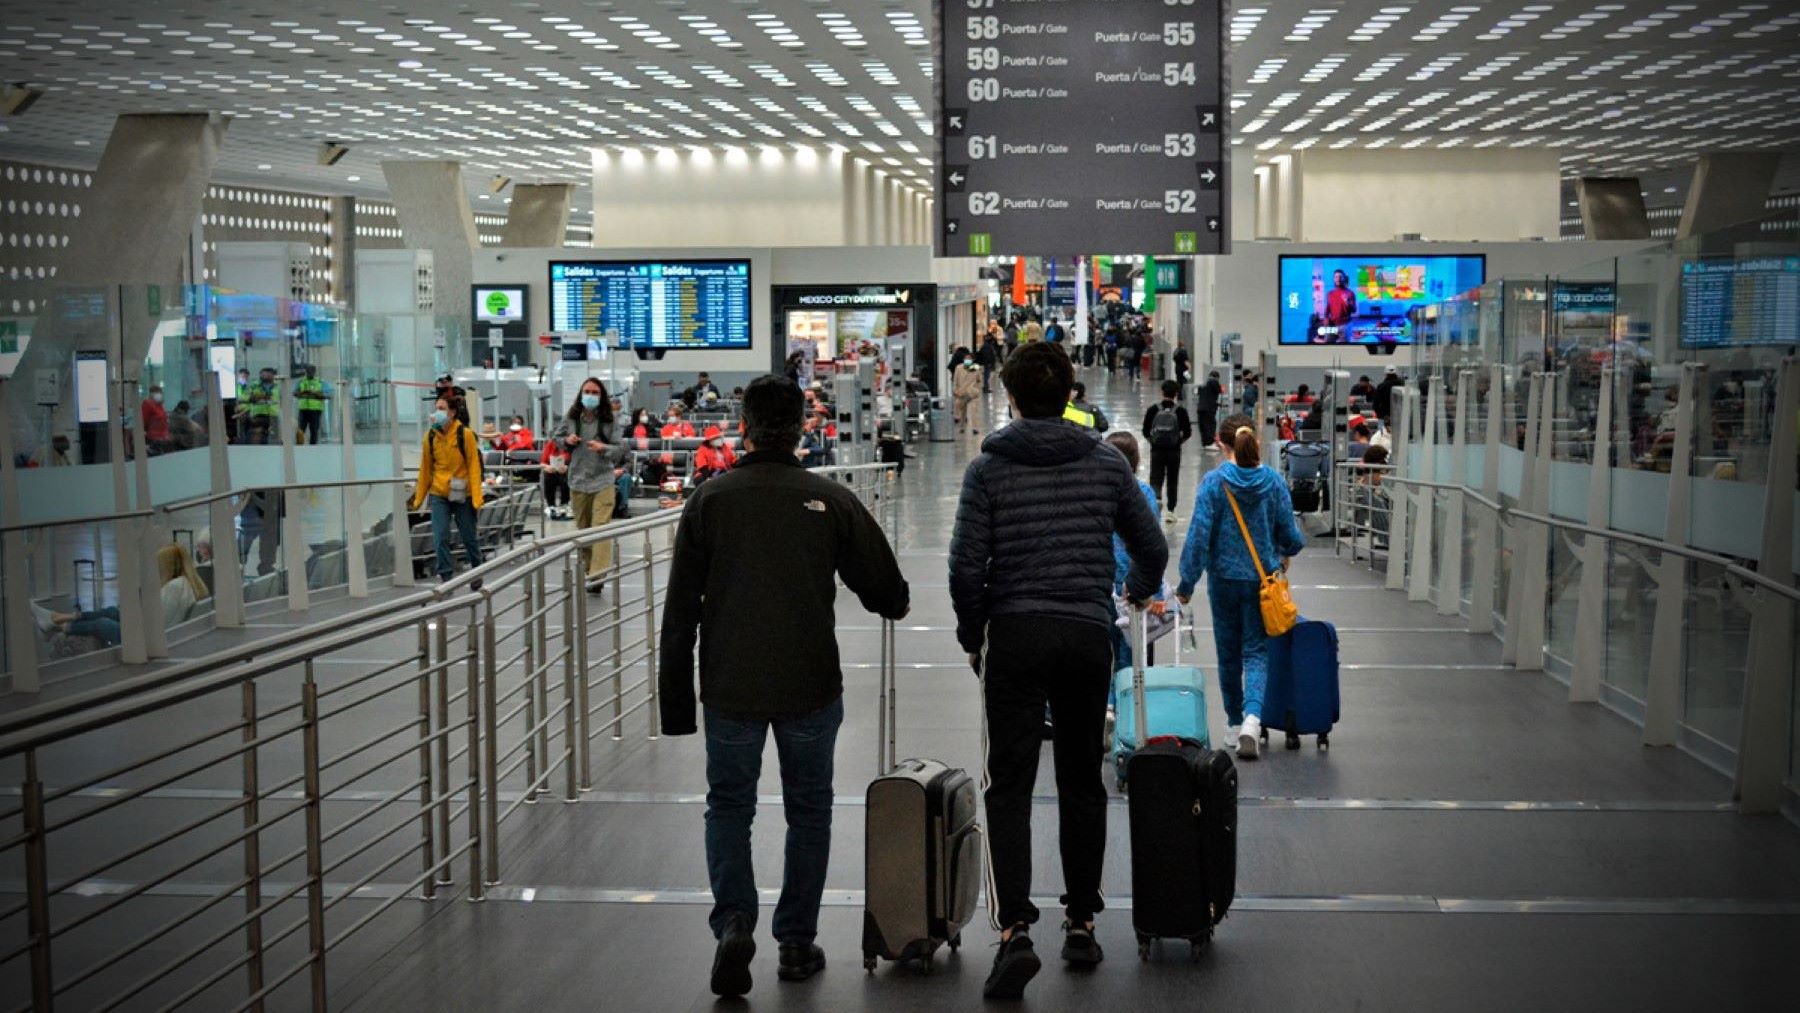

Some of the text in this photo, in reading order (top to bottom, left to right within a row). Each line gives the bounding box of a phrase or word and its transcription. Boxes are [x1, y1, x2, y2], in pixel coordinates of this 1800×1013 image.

[967, 16, 999, 40] 58
[1002, 24, 1037, 34] Puerta
[1046, 24, 1068, 34] Gate
[1095, 31, 1130, 42] Puerta
[1139, 32, 1161, 42] Gate
[1163, 22, 1196, 46] 55
[967, 47, 1000, 70] 59
[1002, 56, 1037, 66] Puerta
[1046, 56, 1068, 66] Gate
[1095, 71, 1130, 82] Puerta
[1139, 72, 1161, 82] Gate
[1164, 62, 1197, 86] 54
[967, 78, 1000, 101] 60
[1002, 87, 1037, 97] Puerta
[1046, 87, 1068, 97] Gate
[967, 135, 997, 159] 61
[1003, 143, 1038, 153] Puerta
[1047, 143, 1069, 153] Gate
[1096, 143, 1131, 153] Puerta
[1140, 144, 1162, 153] Gate
[1164, 133, 1196, 157] 53
[968, 191, 1000, 215] 62
[1003, 198, 1038, 208] Puerta
[1047, 198, 1069, 208] Gate
[1096, 199, 1131, 209] Puerta
[1140, 200, 1162, 209] Gate
[1164, 189, 1197, 213] 52
